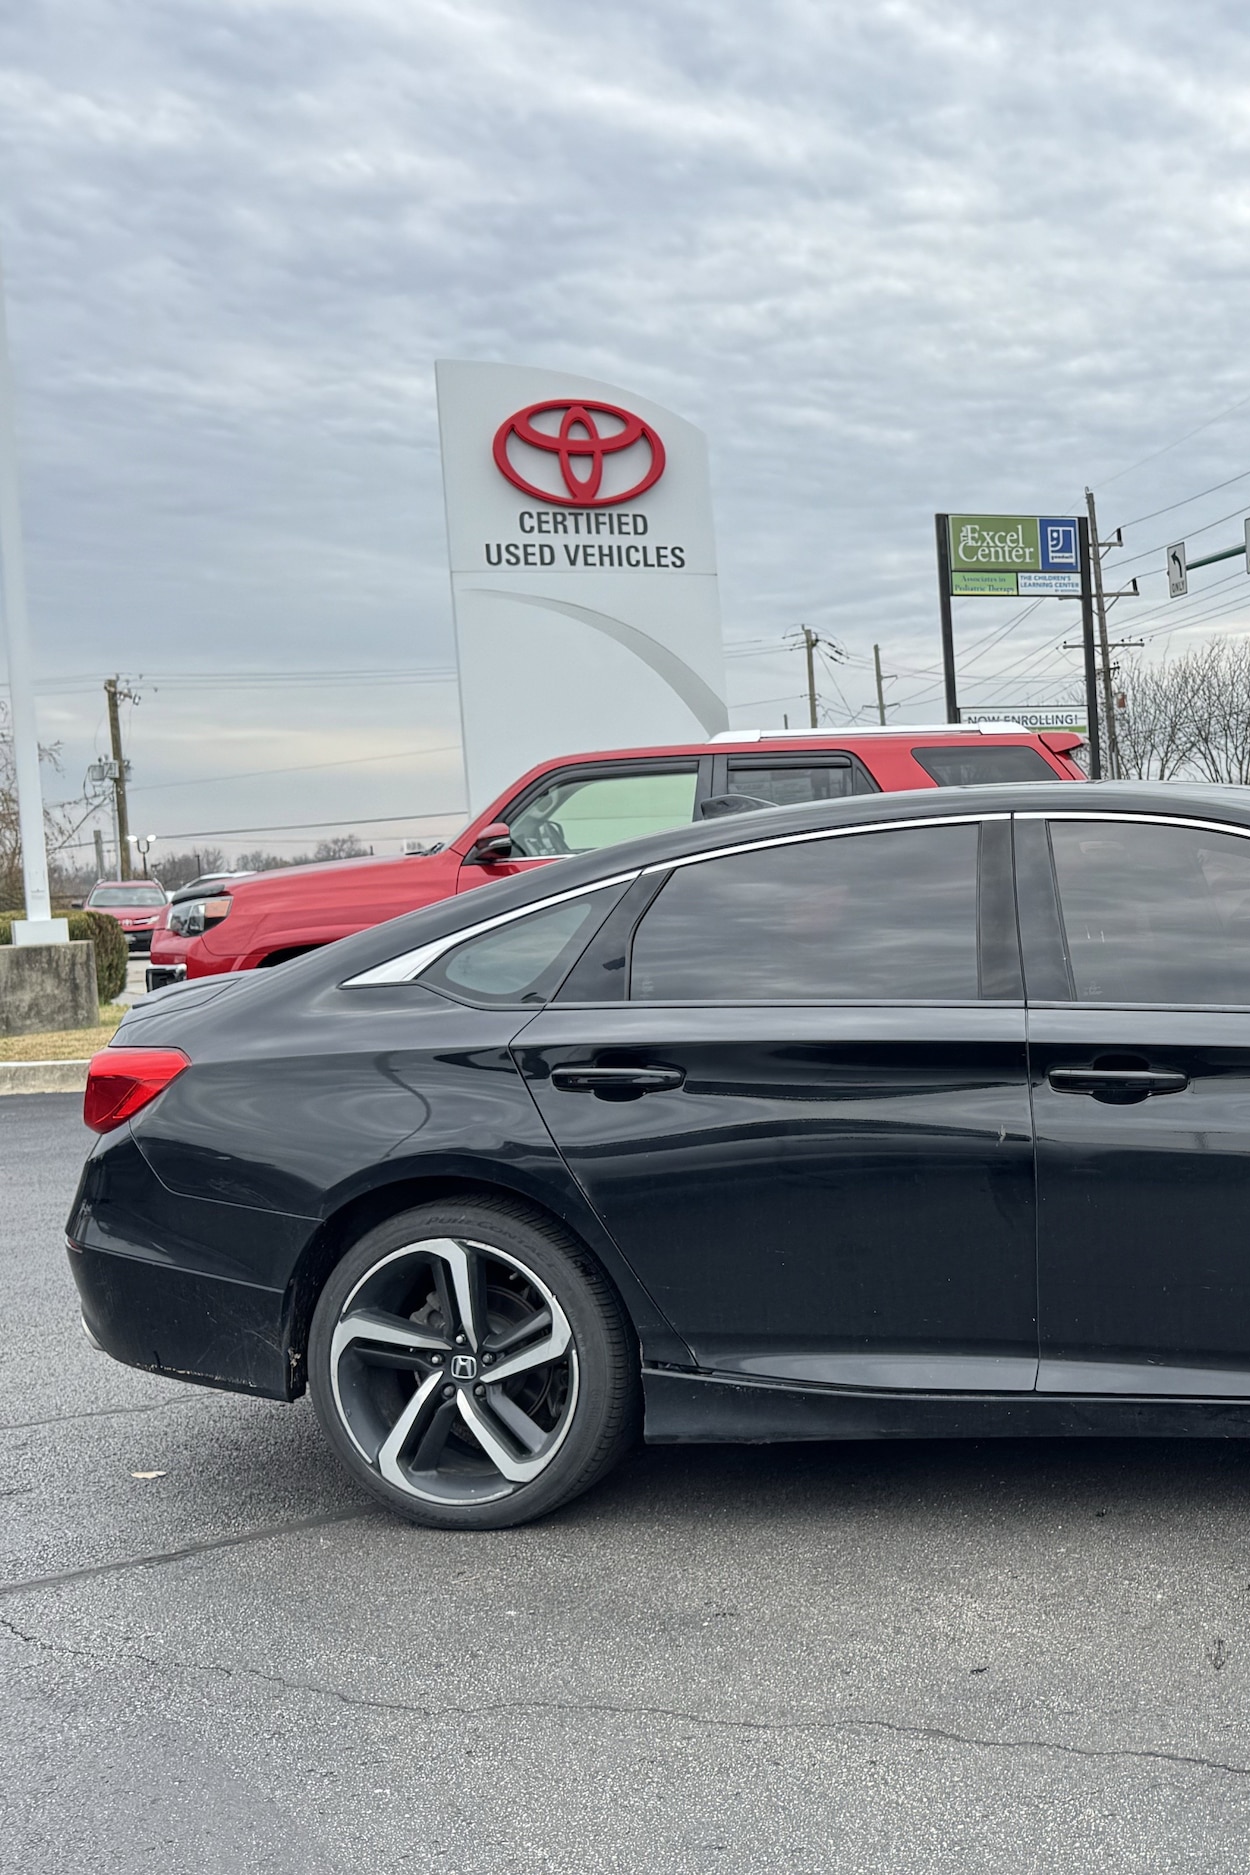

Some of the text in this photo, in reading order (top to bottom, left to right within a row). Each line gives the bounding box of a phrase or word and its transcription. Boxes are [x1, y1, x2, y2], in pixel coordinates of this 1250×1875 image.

[519, 511, 648, 536] CERTIFIED
[965, 524, 1024, 547] Excel
[484, 543, 686, 568] USED VEHICLES
[958, 540, 1034, 562] Center
[1172, 581, 1185, 594] ONLY
[1004, 714, 1077, 726] ENROLLING!
